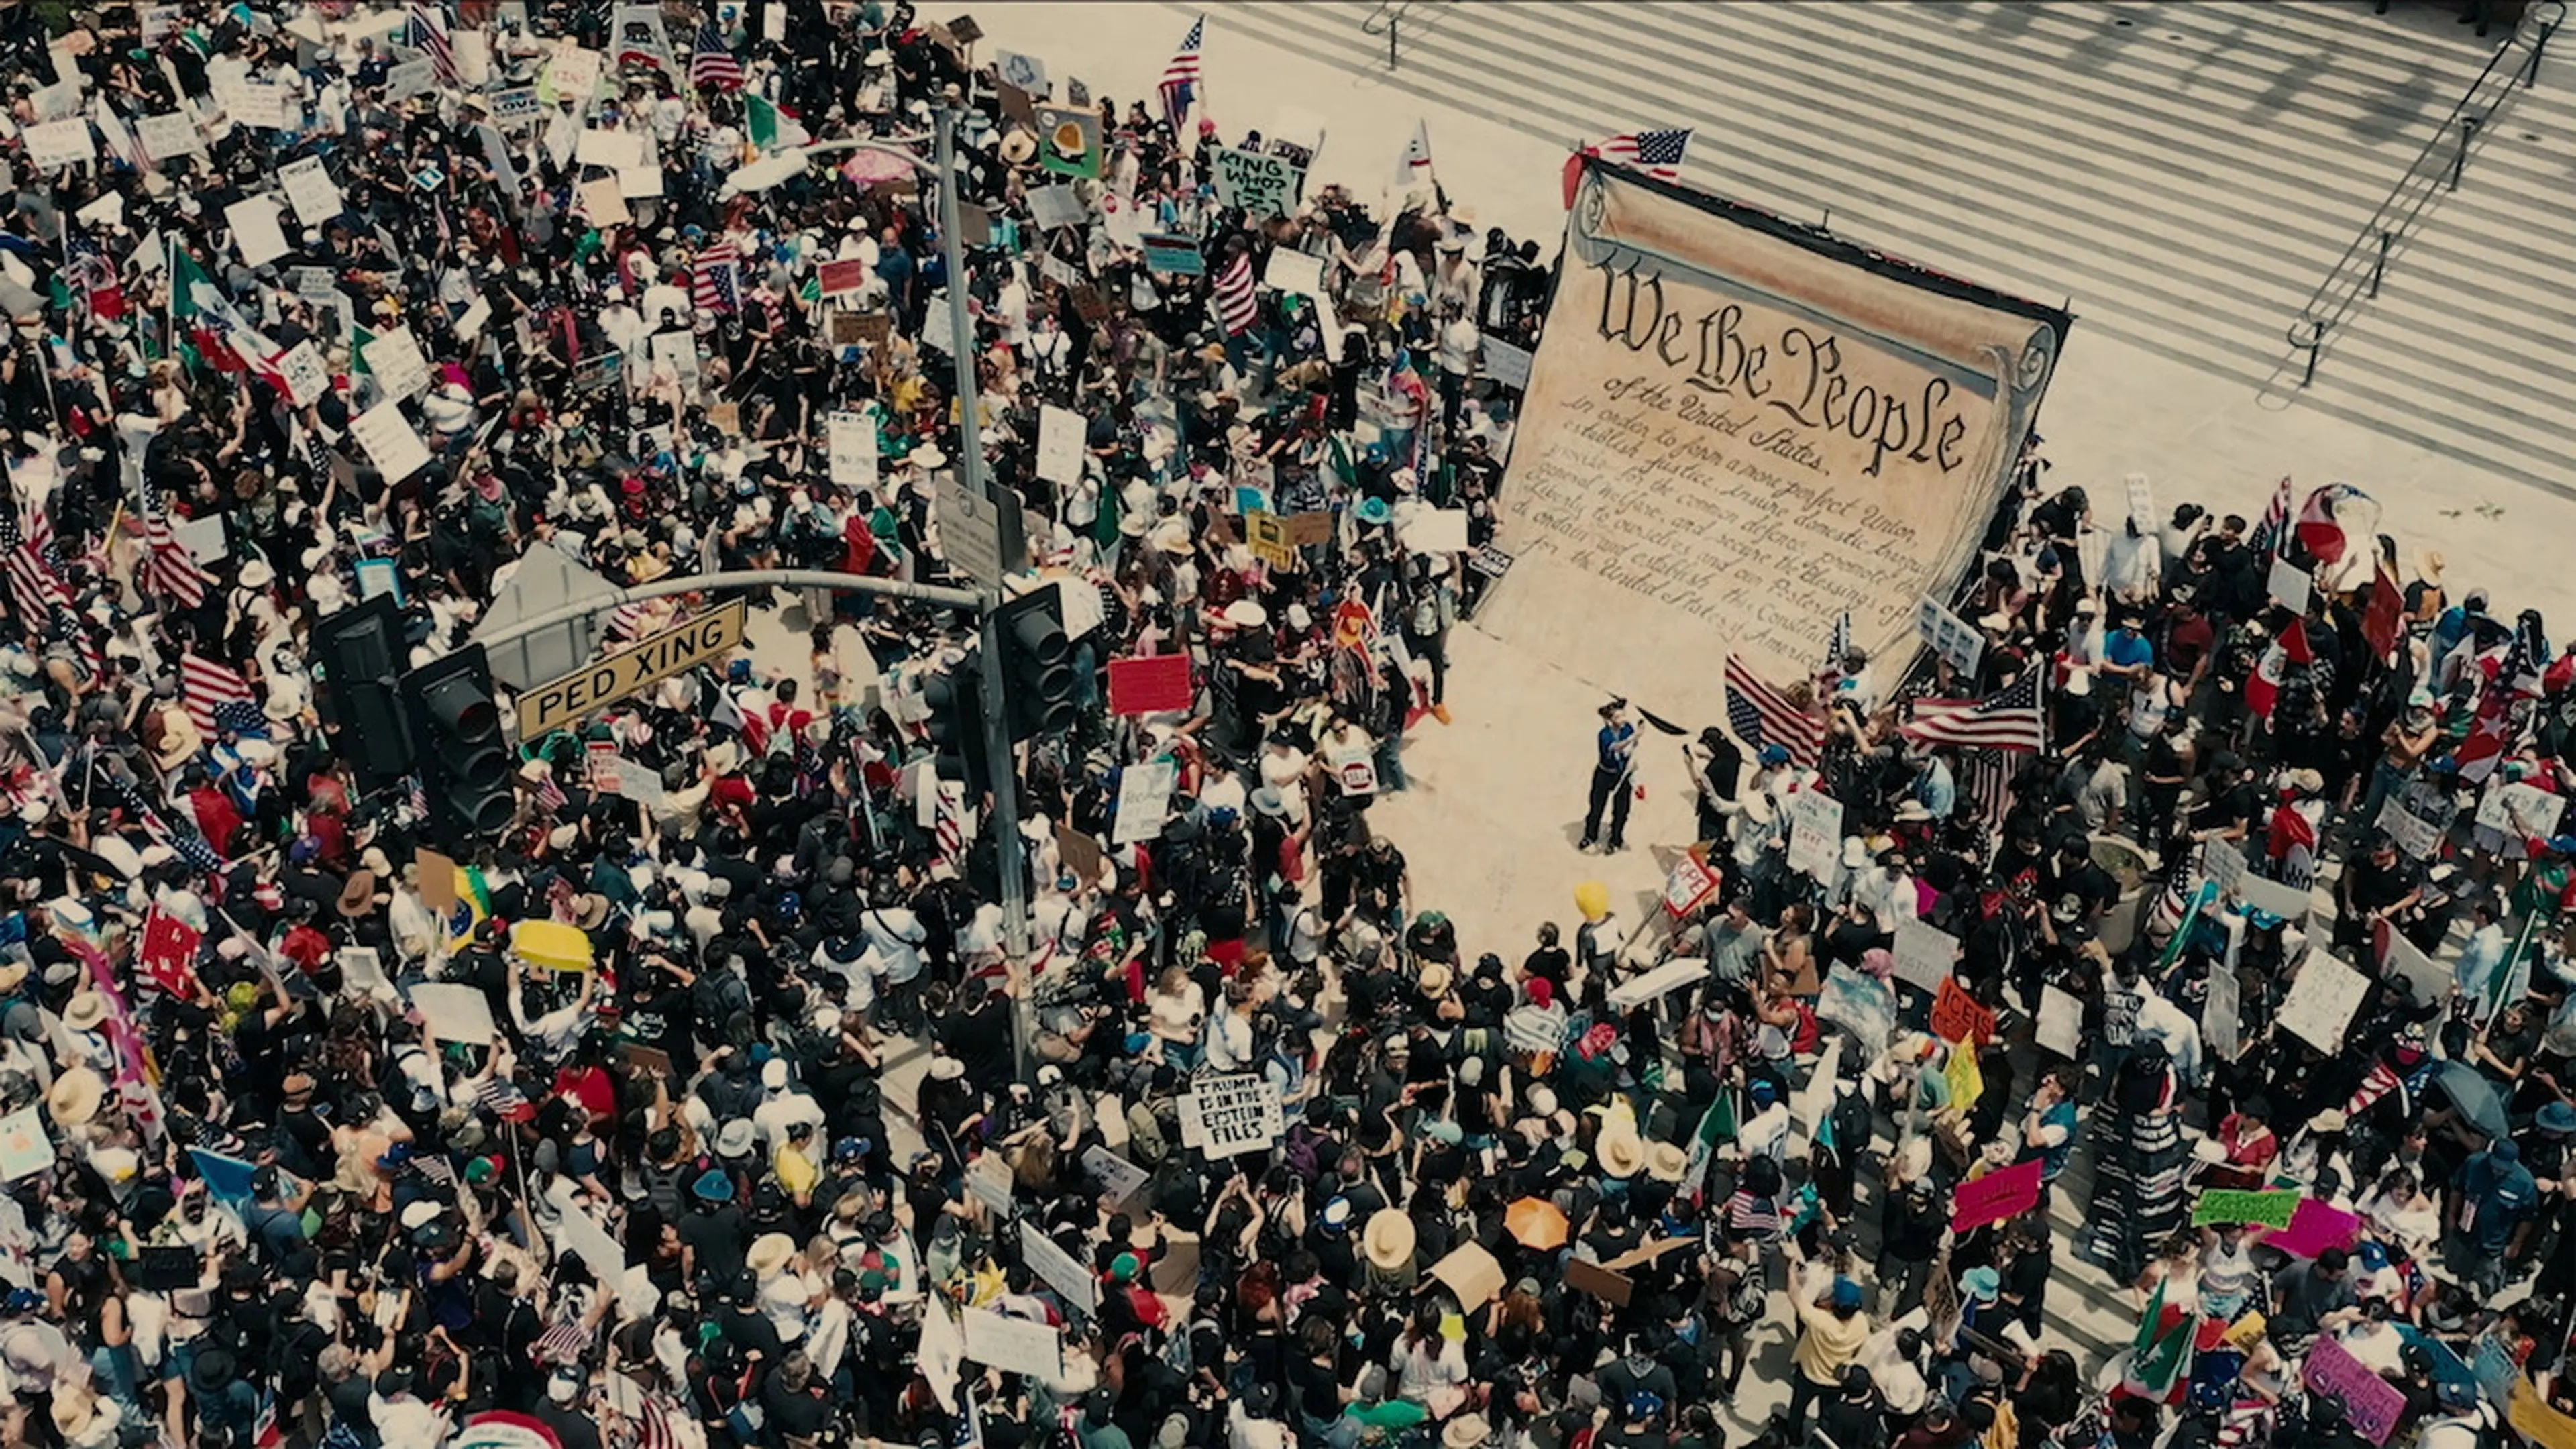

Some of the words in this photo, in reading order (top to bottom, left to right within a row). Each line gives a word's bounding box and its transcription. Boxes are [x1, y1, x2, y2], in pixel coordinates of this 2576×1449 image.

[1217, 150, 1283, 176] KING
[1226, 168, 1287, 196] WHO?
[1586, 247, 1688, 367] We
[1683, 304, 1772, 400] the
[1767, 327, 1966, 478] People
[1603, 376, 1646, 400] of
[1635, 381, 1672, 411] the
[1677, 394, 1758, 438] United
[1563, 420, 1646, 458] establish
[1793, 510, 1870, 550] domestic
[1598, 410, 1650, 438] order
[1655, 427, 1677, 447] to
[1668, 435, 1723, 466] form
[1725, 457, 1740, 471] a
[1738, 464, 1783, 489] more
[1770, 481, 1860, 517] perfect
[1860, 504, 1919, 548] Union,
[1615, 465, 1645, 485] for
[1650, 477, 1675, 497] the
[1676, 493, 1739, 524] common
[1517, 535, 1559, 557] for
[1570, 549, 1595, 571] the
[1599, 557, 1671, 596] United
[1532, 511, 1589, 543] ordain
[1596, 536, 1639, 556] and
[1631, 553, 1718, 590] establish
[1538, 461, 1604, 490] general
[1671, 517, 1717, 536] and
[1715, 535, 1772, 565] secure
[1774, 555, 1803, 575] the
[1878, 604, 1911, 627] of
[1591, 505, 1610, 521] to
[1697, 553, 1746, 572] and
[1734, 569, 1764, 586] our
[1766, 578, 1845, 619] Posterit
[539, 669, 616, 724] PED
[634, 619, 723, 682] XING
[1195, 1077, 1257, 1094] TRUMP
[1201, 1104, 1265, 1128] EPSTEIN
[1216, 1093, 1233, 1108] IN
[1236, 1089, 1261, 1104] THE
[1212, 1120, 1263, 1145] FILES
